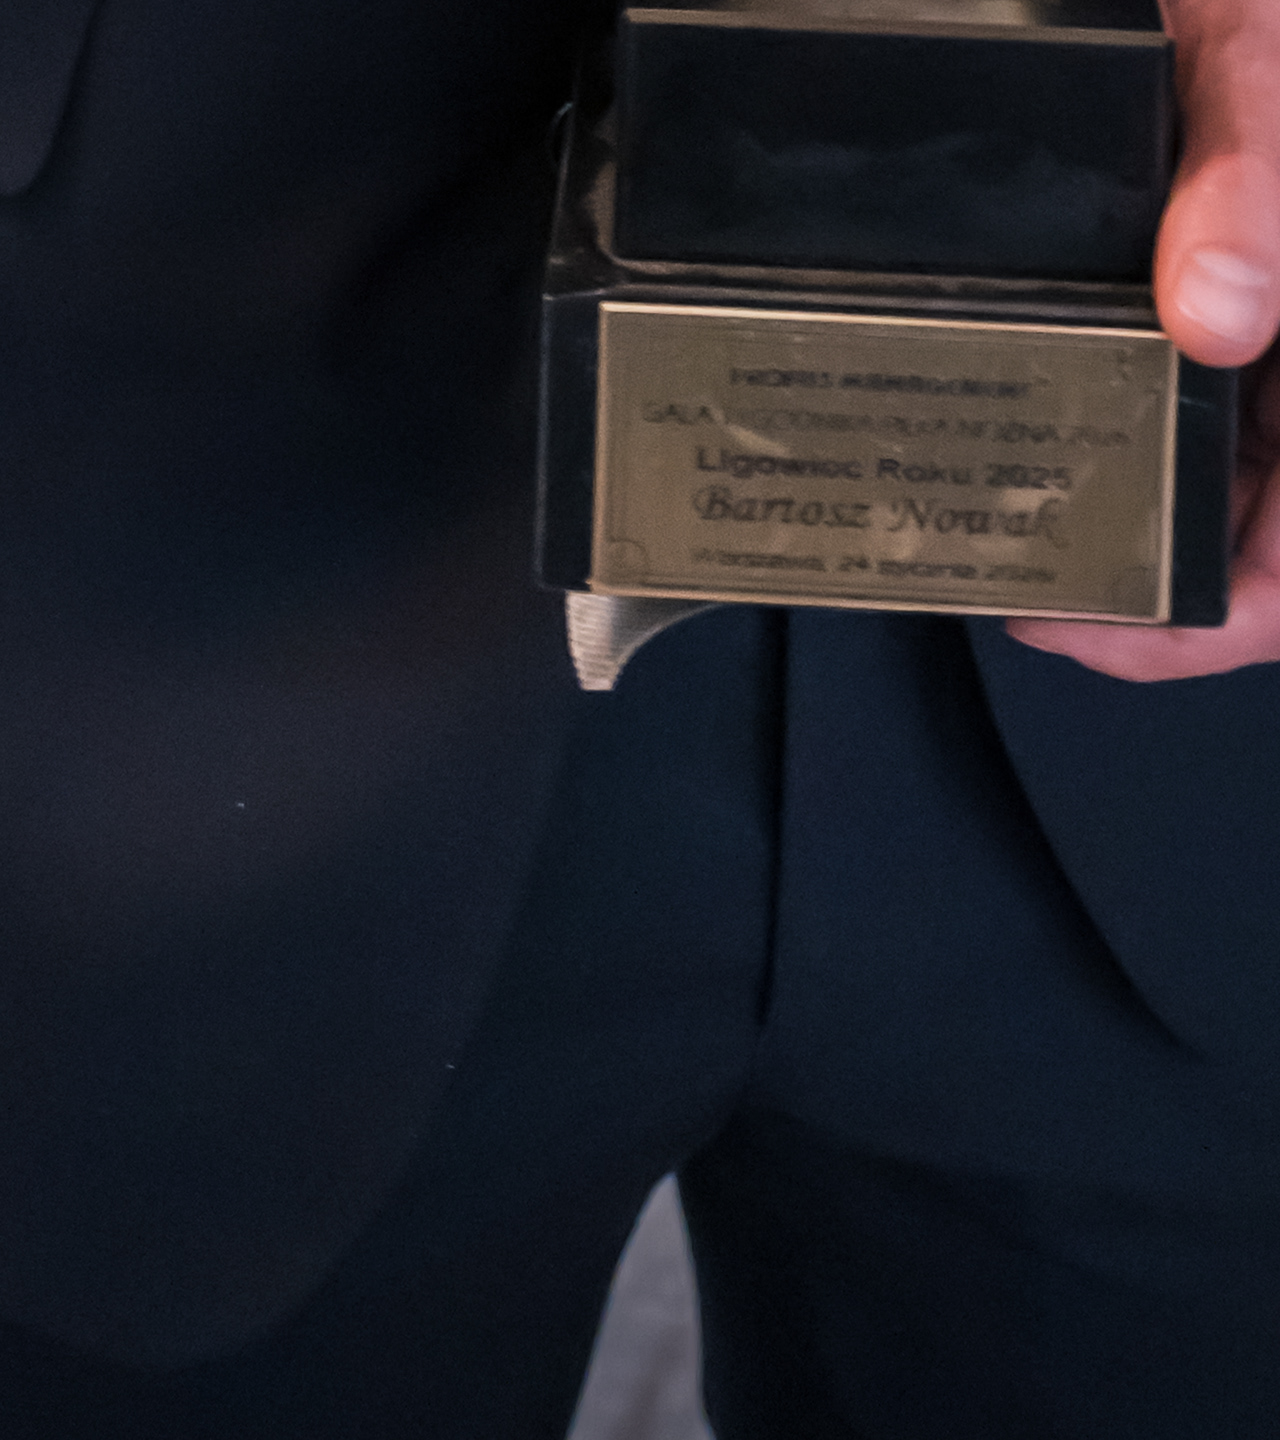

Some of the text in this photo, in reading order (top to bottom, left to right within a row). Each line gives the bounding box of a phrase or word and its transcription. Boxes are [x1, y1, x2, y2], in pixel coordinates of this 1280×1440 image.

[877, 457, 971, 486] Roku
[691, 485, 1071, 549] Bartosz Nowak
